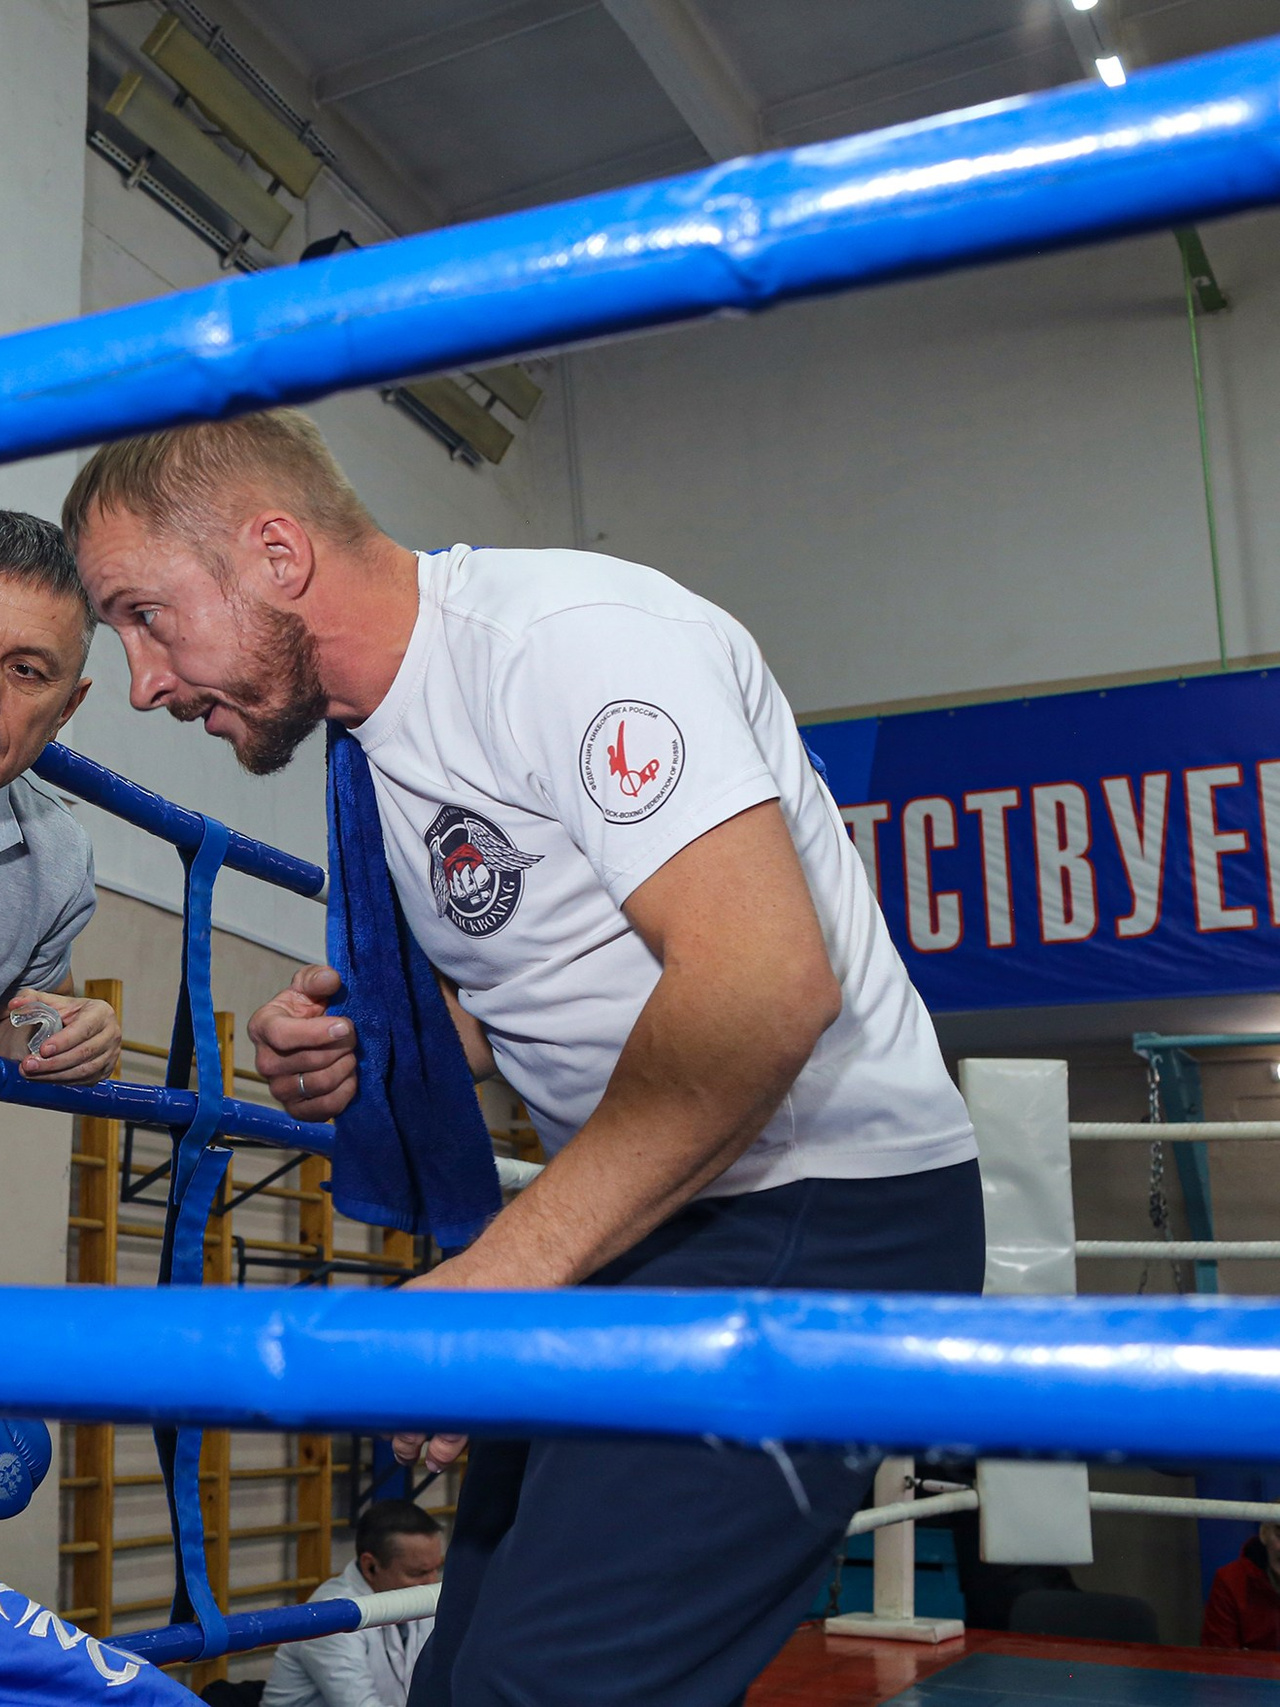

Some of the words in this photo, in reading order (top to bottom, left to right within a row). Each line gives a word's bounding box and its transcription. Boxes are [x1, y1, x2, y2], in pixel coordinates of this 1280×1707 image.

[585, 743, 597, 791] ФЕДЕРАЦИЯ
[628, 706, 659, 720] РОССИИ
[671, 739, 679, 765] RUSSIA
[669, 765, 677, 776] OF
[643, 776, 673, 812] FEDERATION
[451, 880, 515, 932] KICKBOXING
